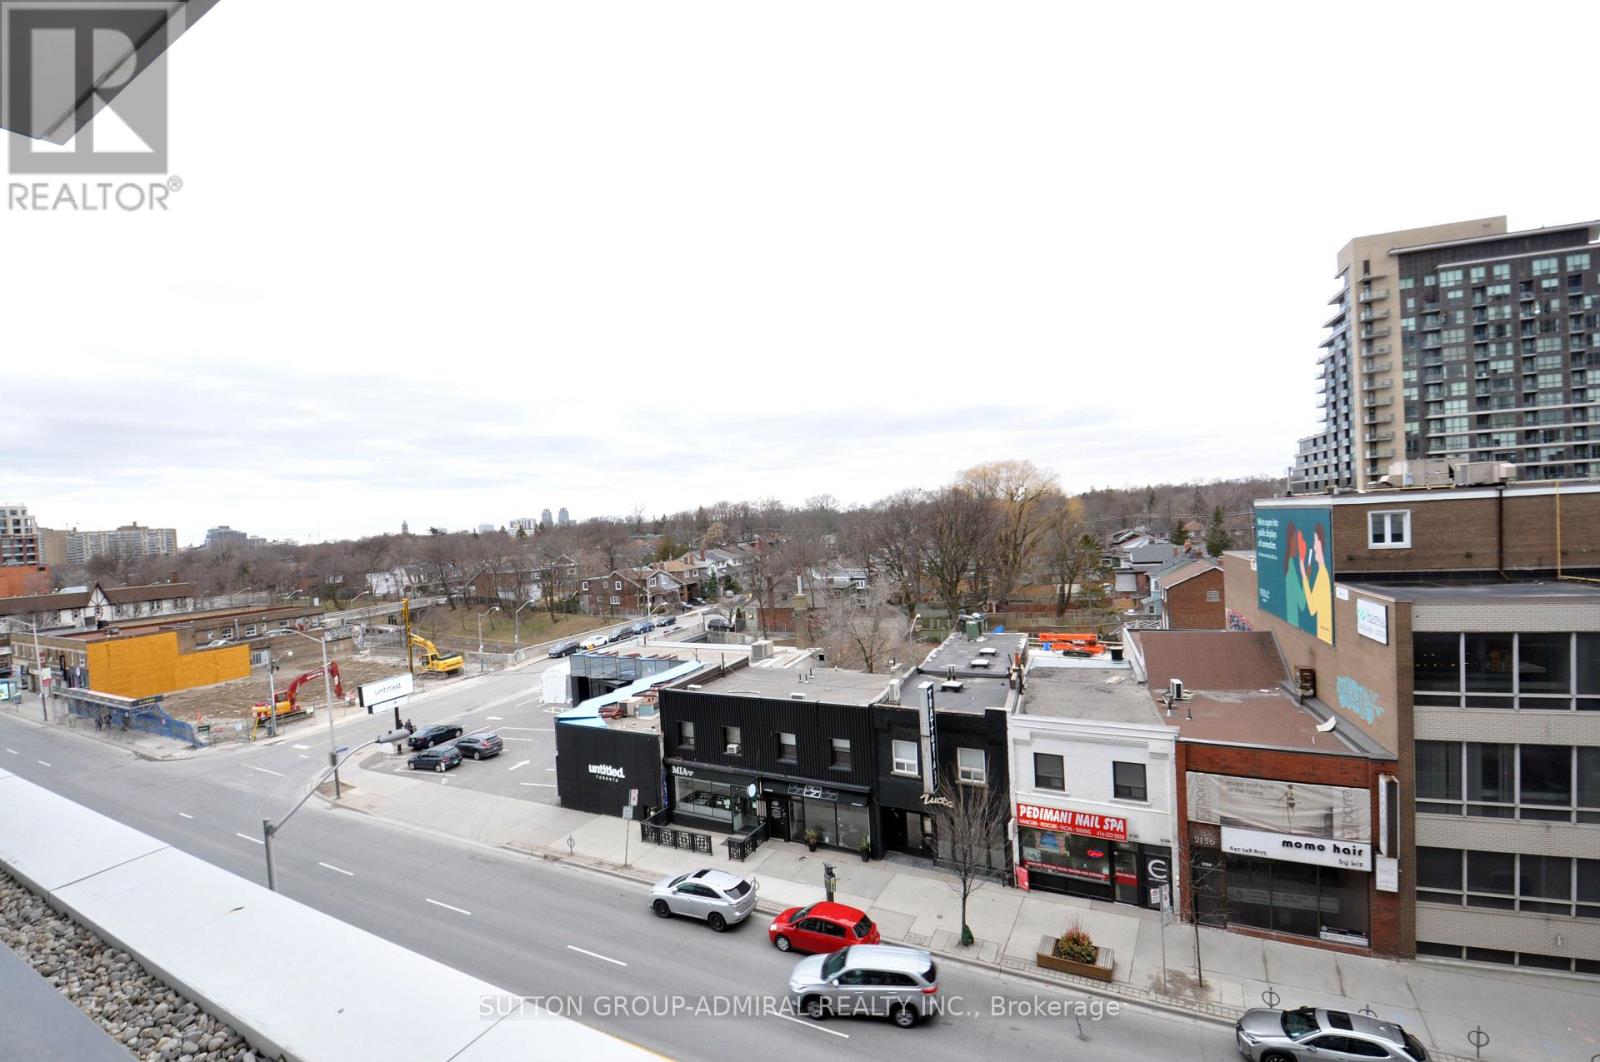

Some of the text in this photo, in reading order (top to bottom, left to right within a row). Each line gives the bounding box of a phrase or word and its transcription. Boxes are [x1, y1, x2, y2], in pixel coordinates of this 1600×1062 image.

[595, 774, 619, 783] TORONTO
[1019, 805, 1124, 832] PEDIMANI NAIL SPA
[1282, 839, 1364, 858] momo hair
[1338, 858, 1349, 867] by
